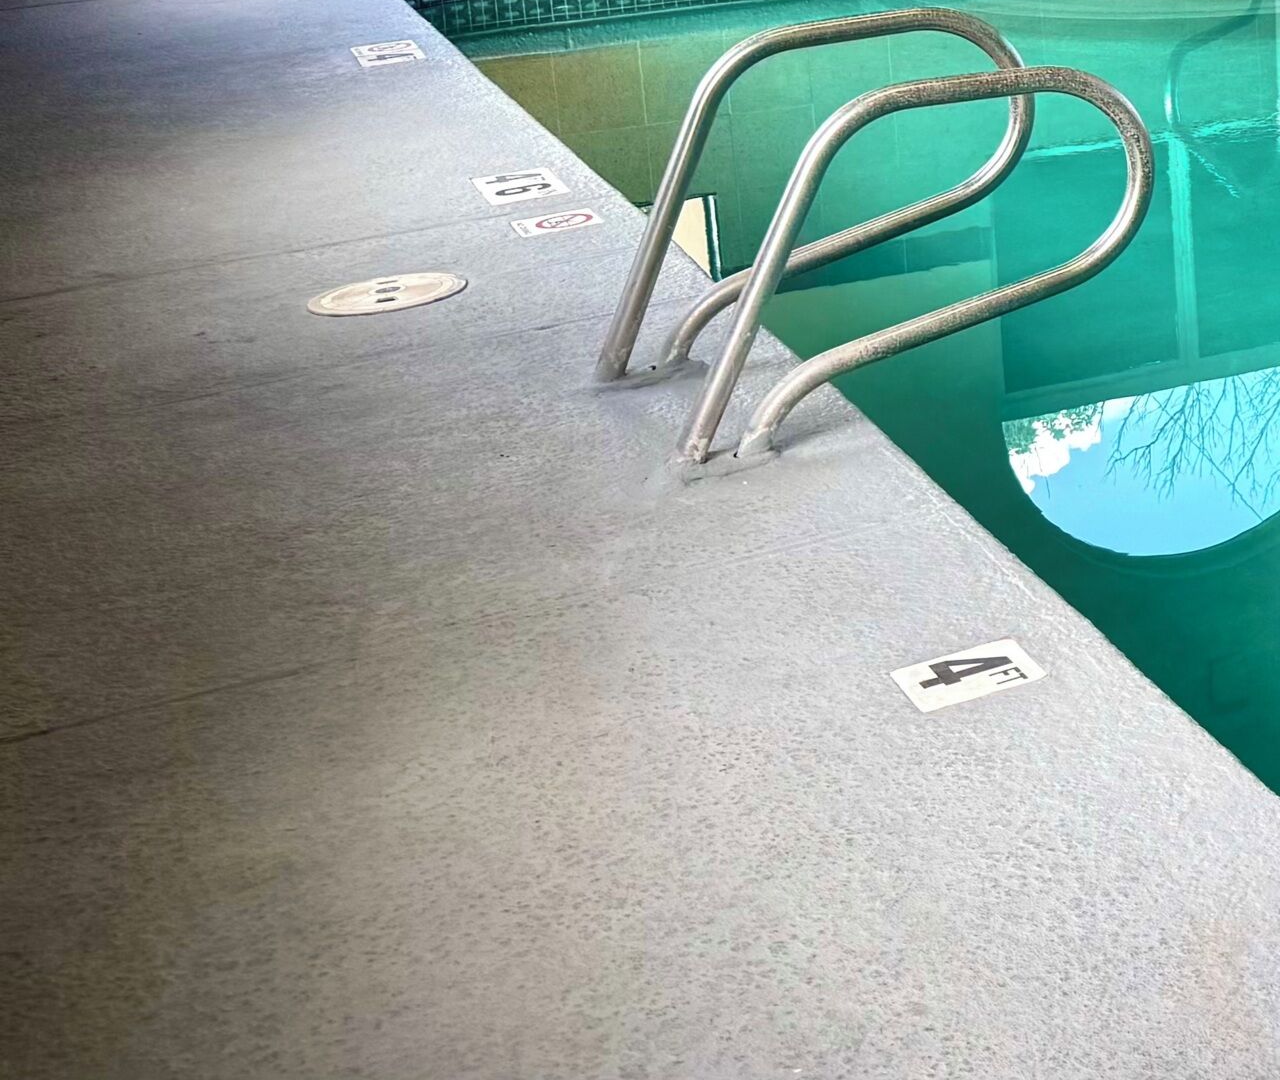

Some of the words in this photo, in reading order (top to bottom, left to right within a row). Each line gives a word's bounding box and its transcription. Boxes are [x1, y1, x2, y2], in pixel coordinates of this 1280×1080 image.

[495, 183, 551, 196] 6
[918, 656, 1013, 689] 4
[989, 666, 1029, 685] FT
